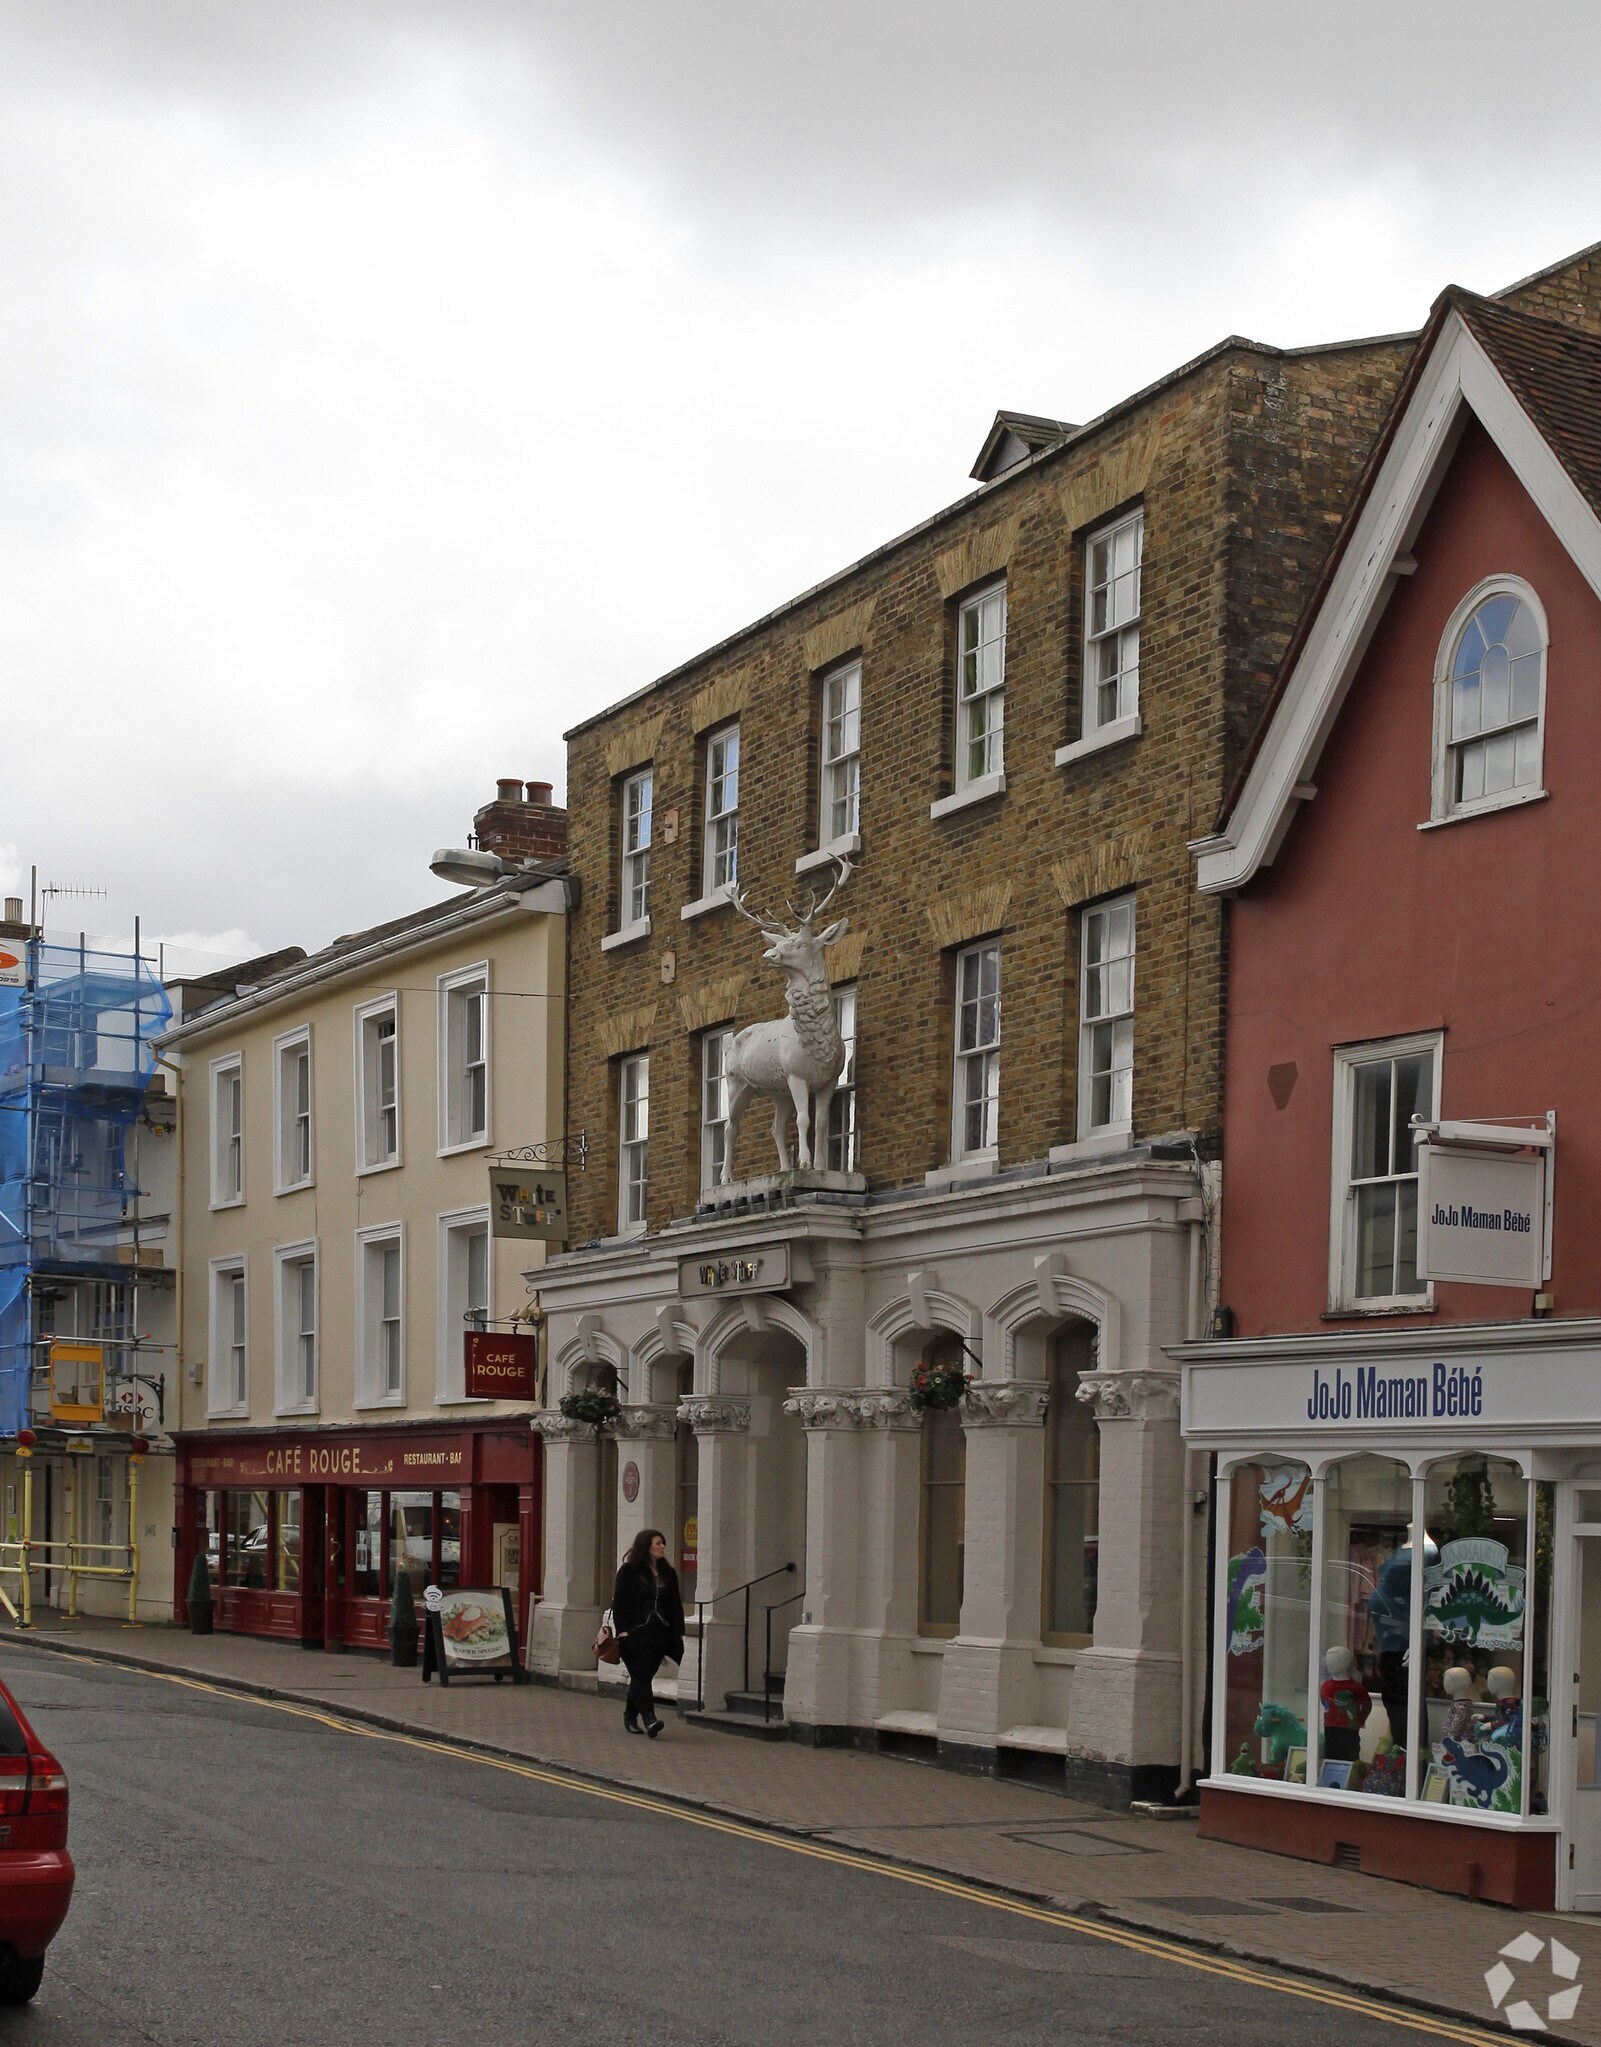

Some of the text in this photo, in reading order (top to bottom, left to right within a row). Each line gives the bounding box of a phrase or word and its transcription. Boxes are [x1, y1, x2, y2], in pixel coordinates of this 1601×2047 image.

[1432, 1203, 1531, 1233] JoJo Maman Bébé
[477, 1364, 525, 1378] ROUGE
[1307, 1363, 1483, 1420] JoJo Maman Bébé
[266, 1445, 361, 1474] CAFÉ ROUGE
[403, 1452, 445, 1465] RESTAURANT
